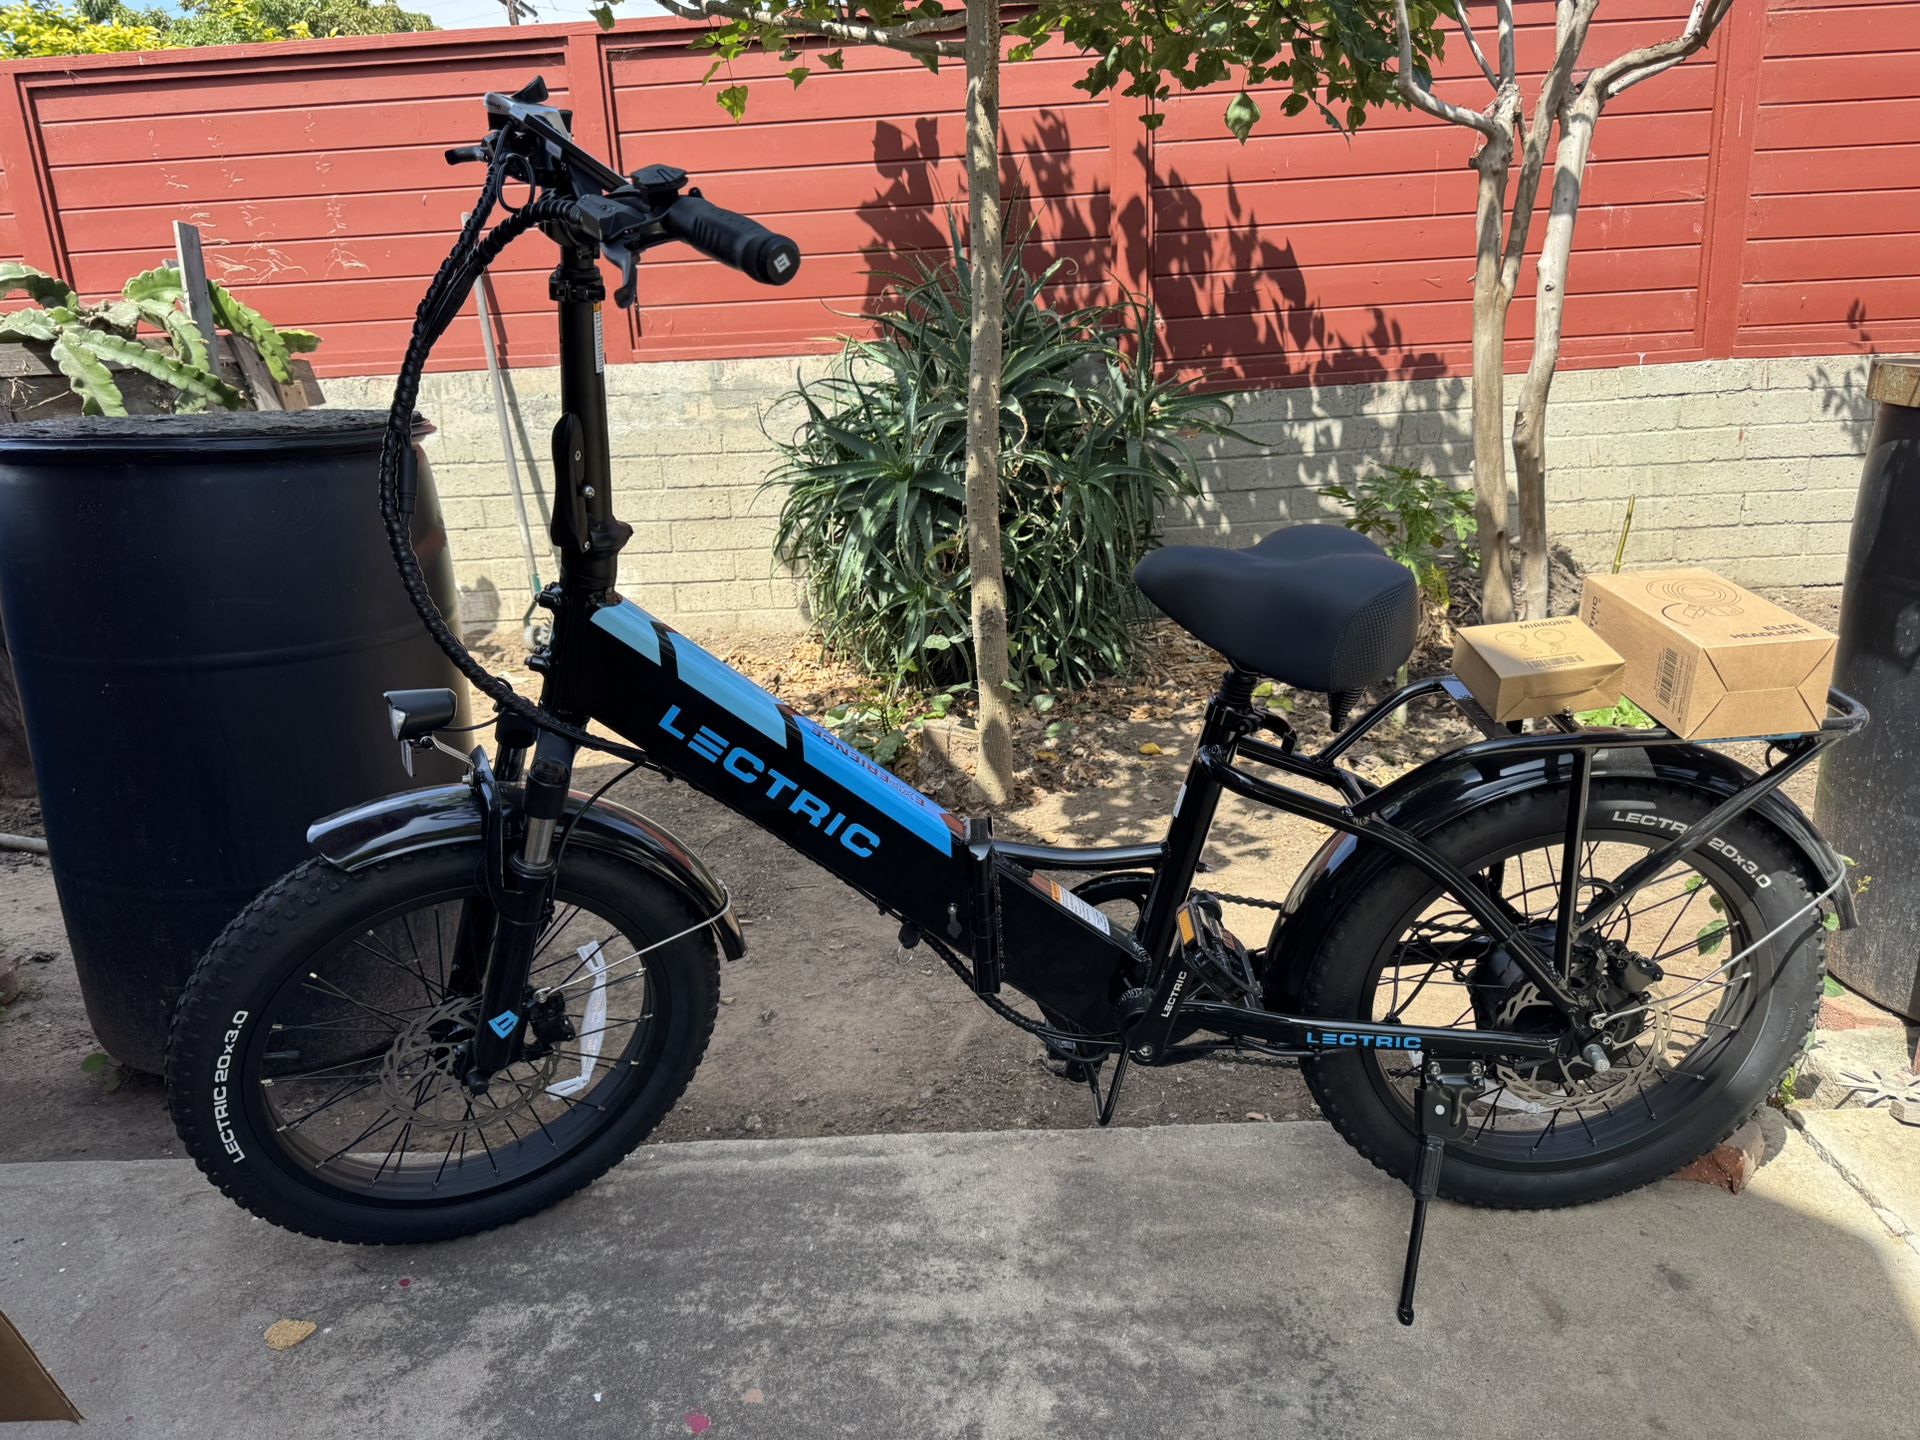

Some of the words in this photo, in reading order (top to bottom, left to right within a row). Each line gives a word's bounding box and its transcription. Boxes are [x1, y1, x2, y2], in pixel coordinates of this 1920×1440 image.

[1519, 619, 1573, 631] MIRRORS
[1730, 628, 1811, 639] HEADLIGHT
[1763, 623, 1804, 632] ELITE
[658, 704, 881, 858] LECTRIC
[1612, 811, 1694, 835] LECTR
[1707, 837, 1772, 889] 20x3.0
[1161, 970, 1188, 1018] LECTRIC
[214, 1010, 249, 1083] 20x3.0
[1306, 1031, 1422, 1049] LECTRIC
[213, 1086, 246, 1164] LECTRIC
